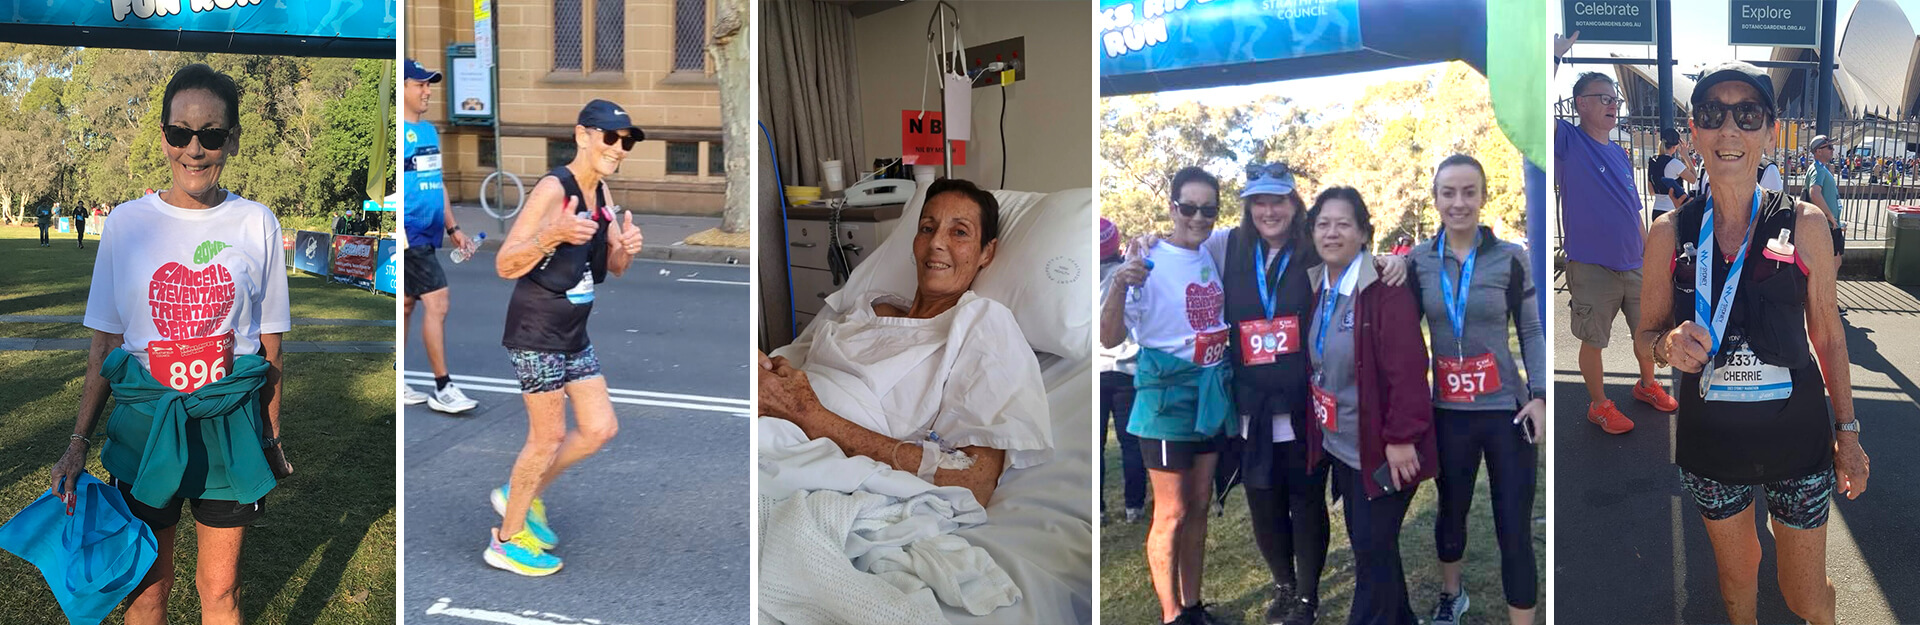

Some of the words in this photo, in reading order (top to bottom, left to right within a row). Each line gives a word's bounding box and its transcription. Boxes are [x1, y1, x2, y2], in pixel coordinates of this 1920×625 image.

[1277, 6, 1328, 20] COUNCIL
[1574, 2, 1639, 16] Celebrate
[1742, 5, 1791, 21] Explore
[1102, 17, 1169, 58] RUN
[909, 118, 923, 134] N
[930, 119, 942, 134] B
[193, 240, 232, 264] BOWEL
[152, 262, 217, 286] CANCER
[217, 263, 232, 283] IS
[148, 280, 235, 304] PREVENTABLE
[148, 300, 234, 321] TREATABLE
[152, 316, 226, 340] BEATABLE
[216, 340, 223, 352] 5
[170, 356, 226, 390] 896
[1447, 372, 1486, 393] 957
[1723, 371, 1762, 381] CHERRIE
